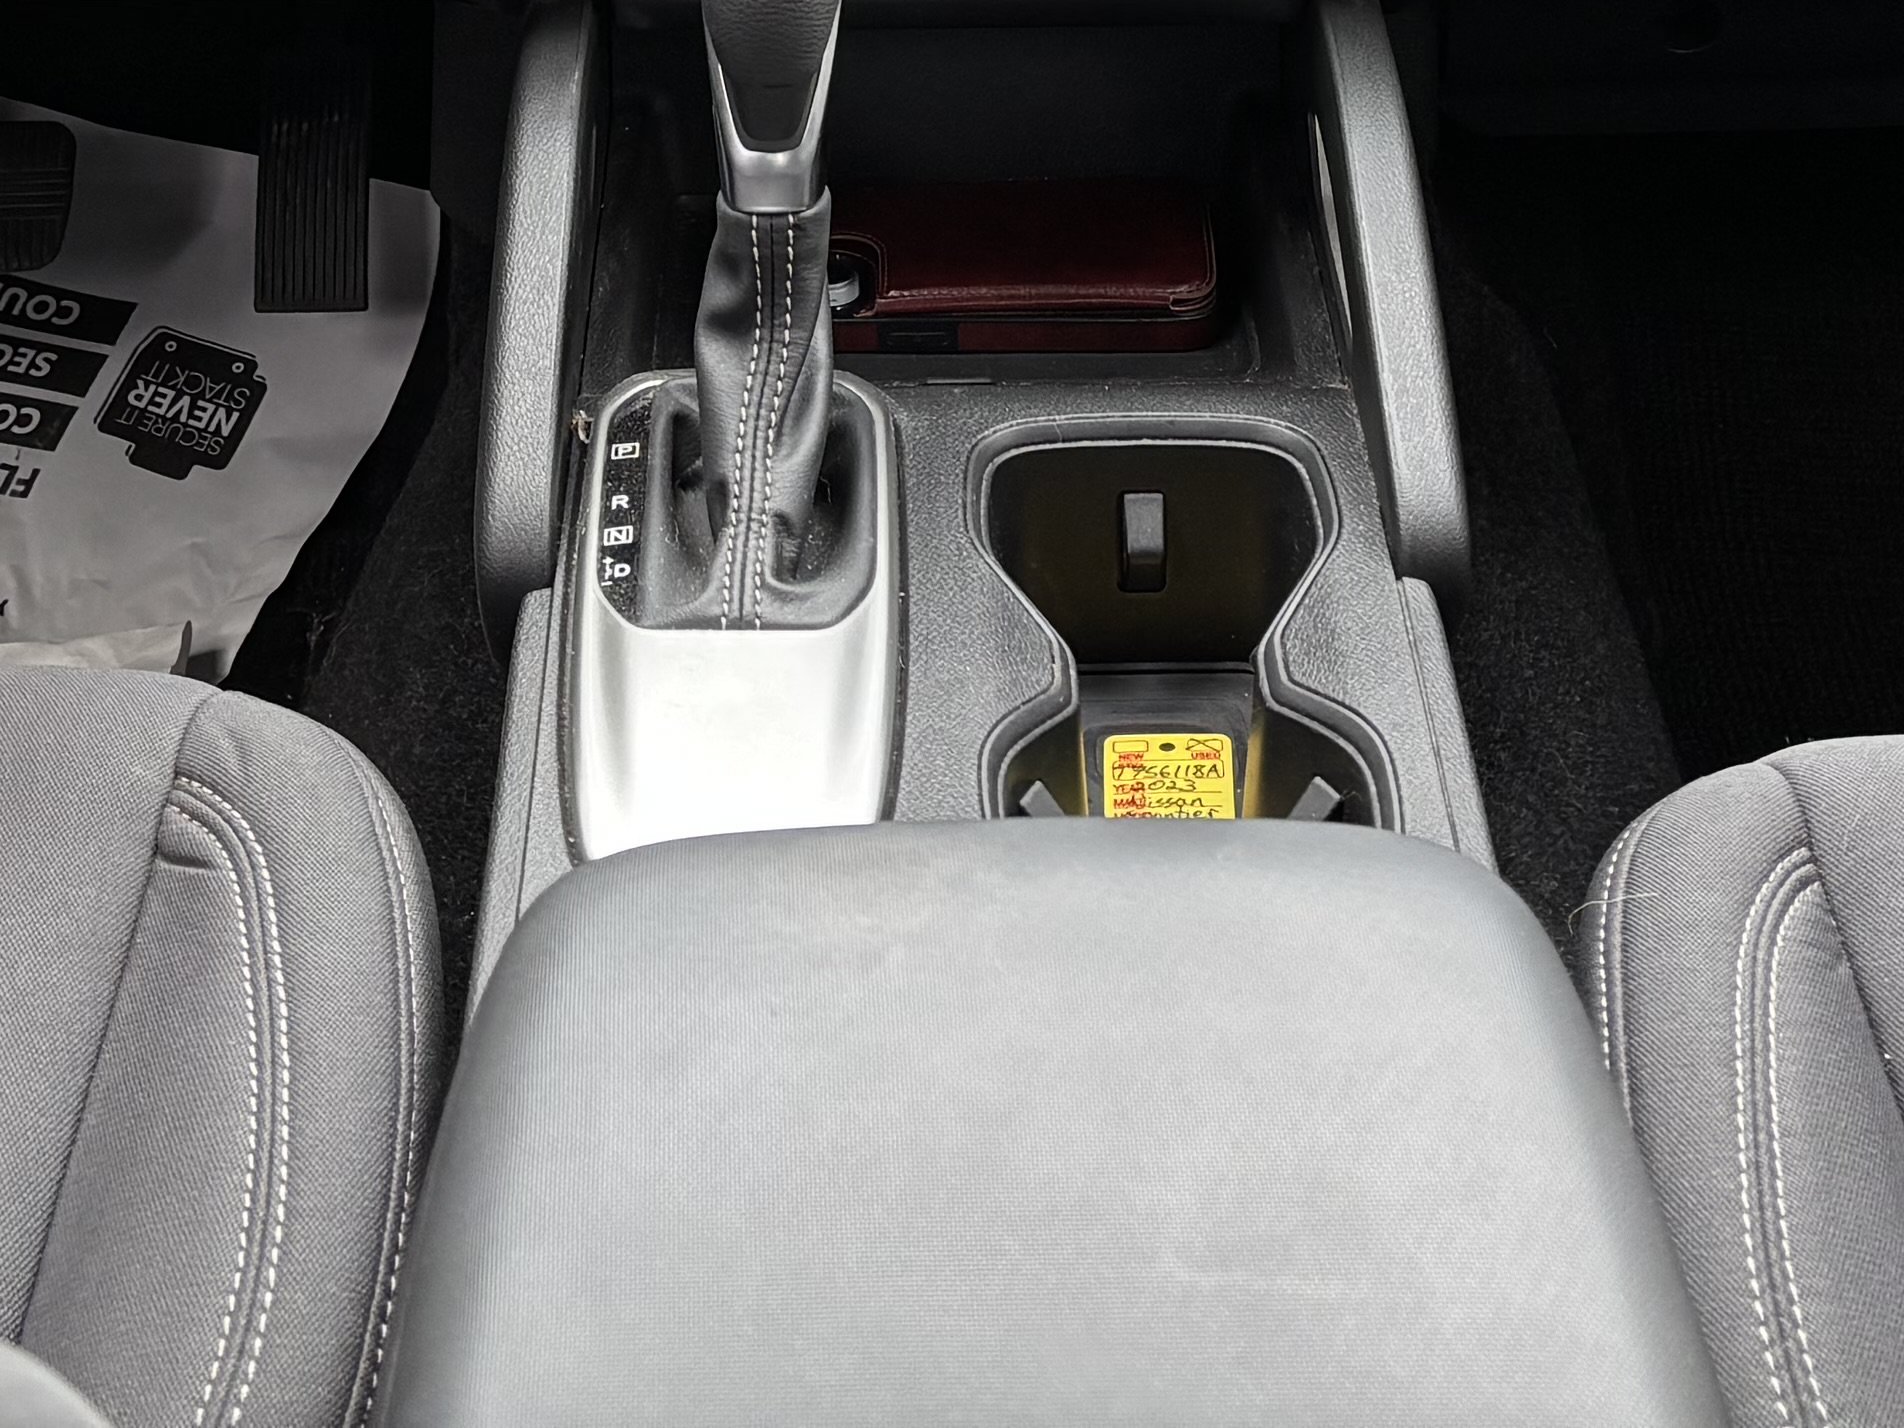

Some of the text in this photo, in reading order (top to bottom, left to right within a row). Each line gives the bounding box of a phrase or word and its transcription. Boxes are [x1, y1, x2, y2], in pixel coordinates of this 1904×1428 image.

[140, 360, 251, 410] STACK IT
[127, 378, 241, 438] NEVER
[114, 408, 226, 456] SECURE IT
[618, 446, 634, 457] P
[611, 495, 631, 510] R
[610, 529, 627, 542] N
[614, 563, 631, 578] D
